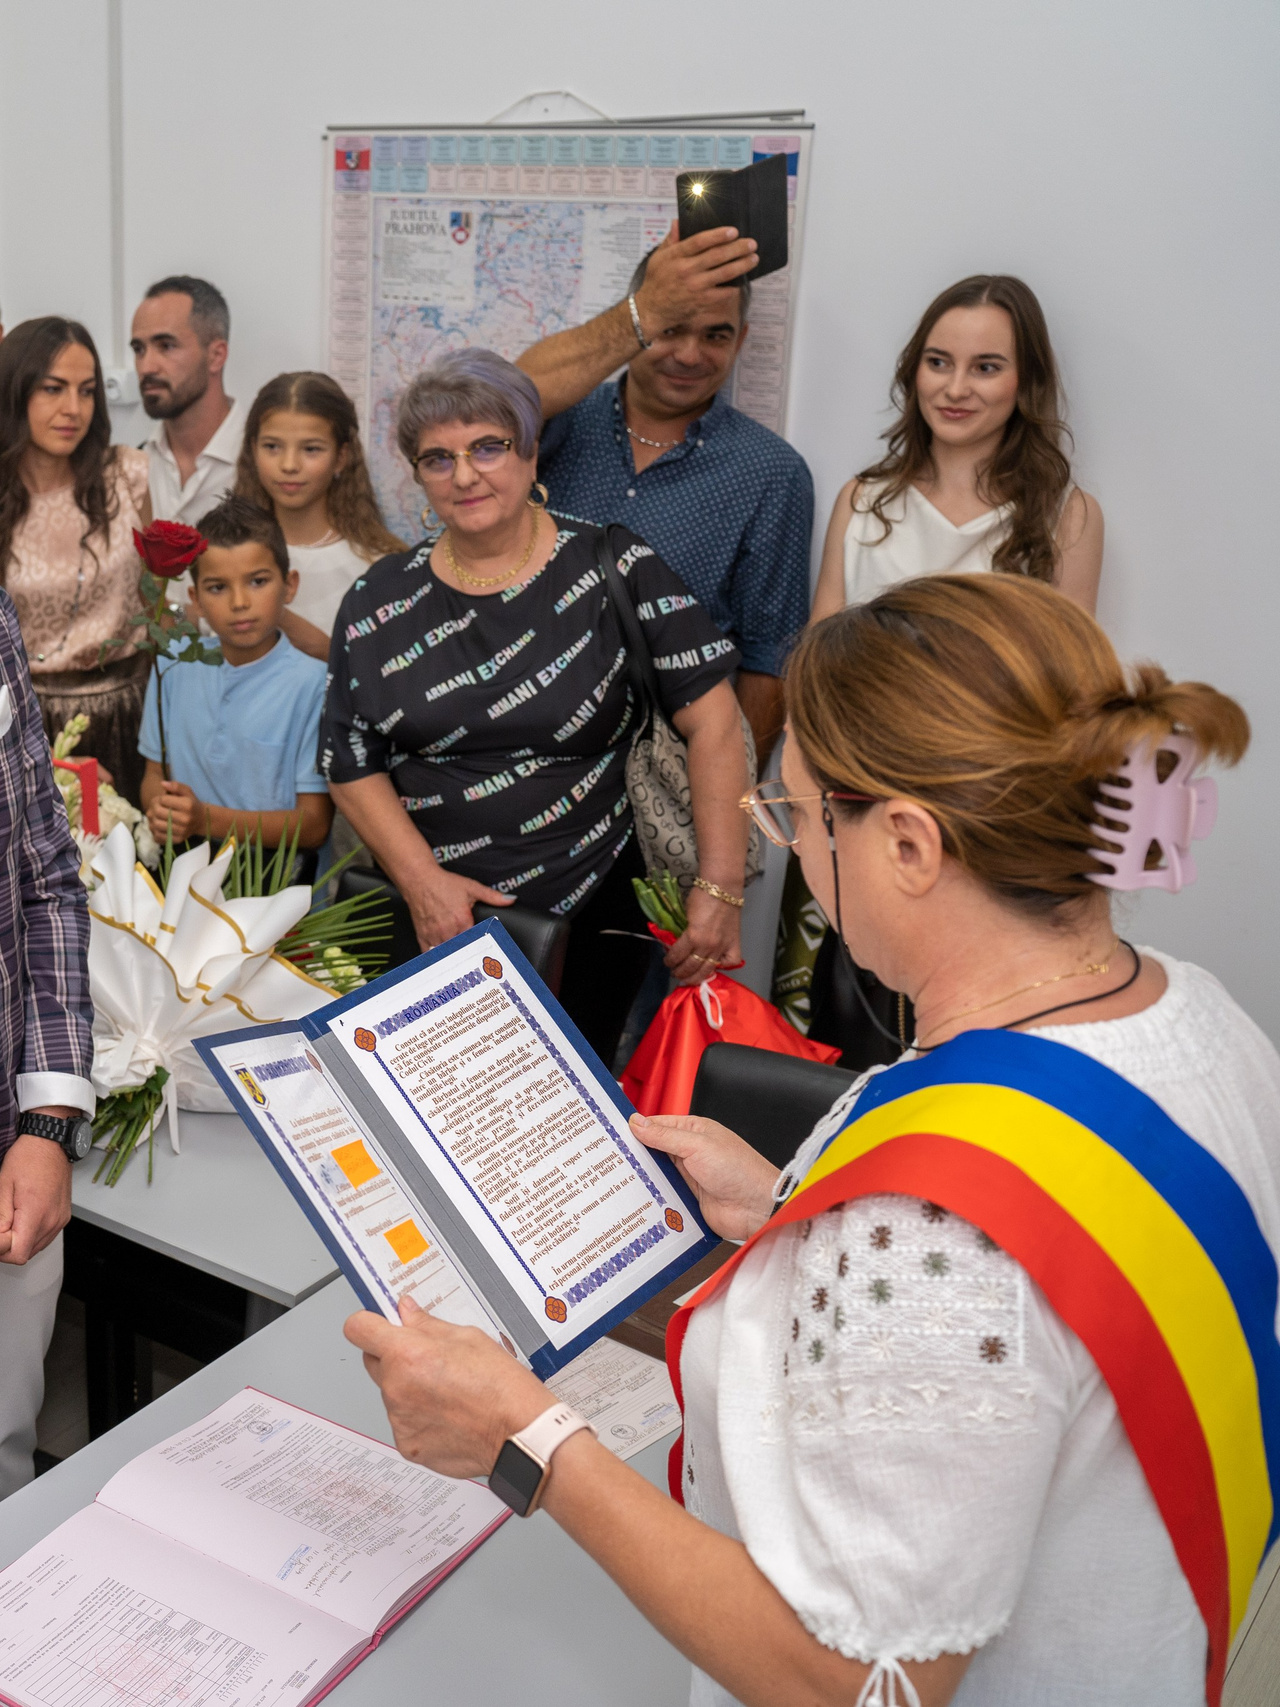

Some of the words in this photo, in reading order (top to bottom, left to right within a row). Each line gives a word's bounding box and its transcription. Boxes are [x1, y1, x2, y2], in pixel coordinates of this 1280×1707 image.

[554, 569, 601, 615] ARMANI
[425, 670, 477, 702] ARMANI
[476, 628, 537, 681] EXCHANGE
[487, 679, 538, 721] ARMANI
[536, 629, 594, 688] EXCHANGE
[653, 649, 701, 671] RMANI
[553, 699, 597, 743] ARMANI
[463, 770, 516, 802] ARMANI
[520, 796, 572, 835] ARMANI
[433, 835, 493, 864] EXCHANGE
[390, 1052, 409, 1065] cerute
[415, 1040, 428, 1050] lege
[428, 1029, 448, 1045] pentru
[395, 1035, 419, 1051] Constat
[435, 1019, 447, 1029] fost
[402, 1059, 413, 1067] fac
[413, 1042, 442, 1061] cunoscute
[500, 1002, 511, 1010] din
[448, 1054, 459, 1063] este
[459, 1041, 482, 1056] uniunea
[480, 1033, 494, 1043] liber
[399, 1064, 419, 1078] Codul
[443, 1105, 467, 1122] Familia
[466, 1099, 476, 1108] are
[476, 1085, 497, 1102] dreptul
[502, 1070, 523, 1085] ocrotire
[522, 1064, 532, 1073] din
[531, 1054, 548, 1069] partea
[455, 1122, 474, 1137] Statul
[476, 1116, 486, 1125] are
[547, 1069, 559, 1082] prin
[475, 1115, 504, 1136] economice
[477, 1151, 501, 1168] Familia
[536, 1123, 547, 1132] pe
[566, 1098, 580, 1110] liber
[491, 1118, 515, 1138] precum
[529, 1138, 537, 1147] pe
[478, 1172, 502, 1192] precum
[514, 1158, 522, 1167] pe
[526, 1139, 548, 1158] dreptul
[562, 1152, 582, 1168] respect
[486, 1187, 510, 1204] copiilor
[516, 1215, 525, 1224] Ei
[526, 1210, 534, 1218] au
[577, 1168, 593, 1181] locui
[530, 1185, 550, 1201] sprijin
[551, 1267, 562, 1275] În
[561, 1257, 577, 1270] urma
[558, 1263, 582, 1286] personal
[606, 1234, 622, 1249] declar
